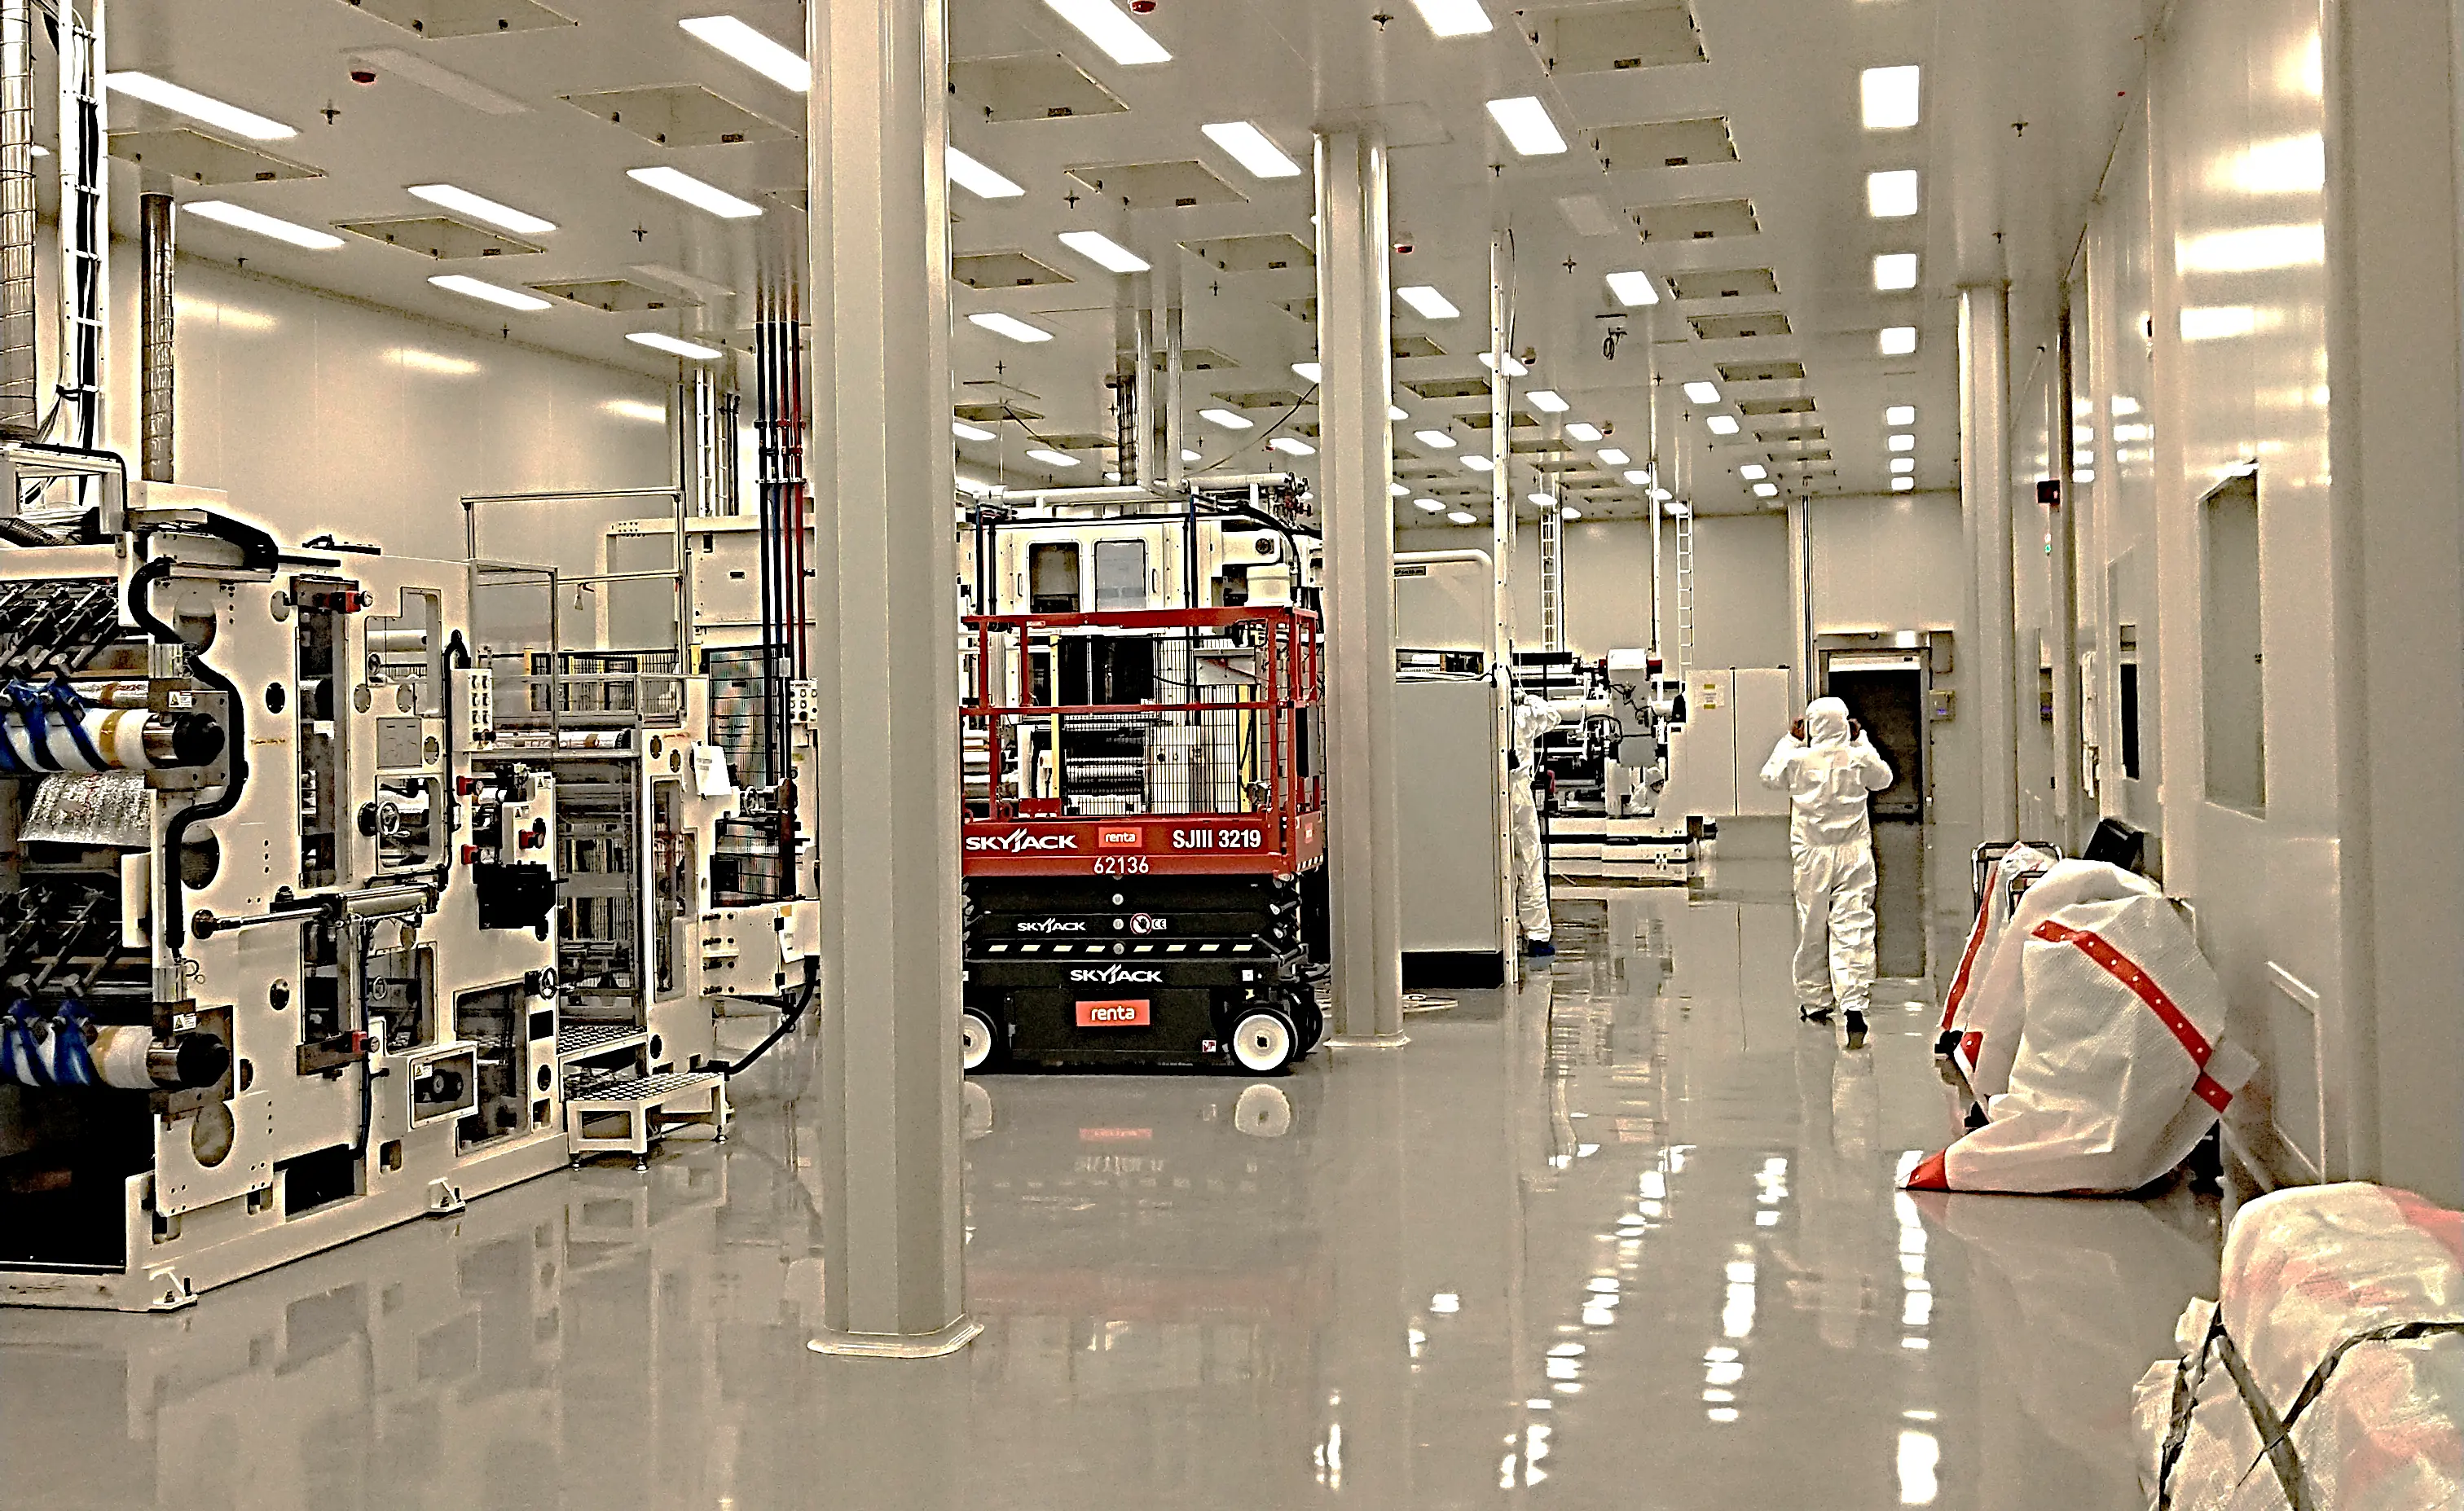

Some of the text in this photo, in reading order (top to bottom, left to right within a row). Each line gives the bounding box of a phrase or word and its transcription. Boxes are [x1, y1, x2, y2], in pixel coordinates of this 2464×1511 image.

[966, 828, 1078, 853] SKYJACK
[1105, 831, 1136, 843] renta
[1173, 829, 1261, 849] SJIII 3219
[1093, 856, 1149, 874] 62136
[1017, 917, 1086, 933] SKYJACK
[1154, 919, 1166, 929] CE
[1070, 964, 1164, 985] SKYJACK
[1091, 1005, 1135, 1021] renta
